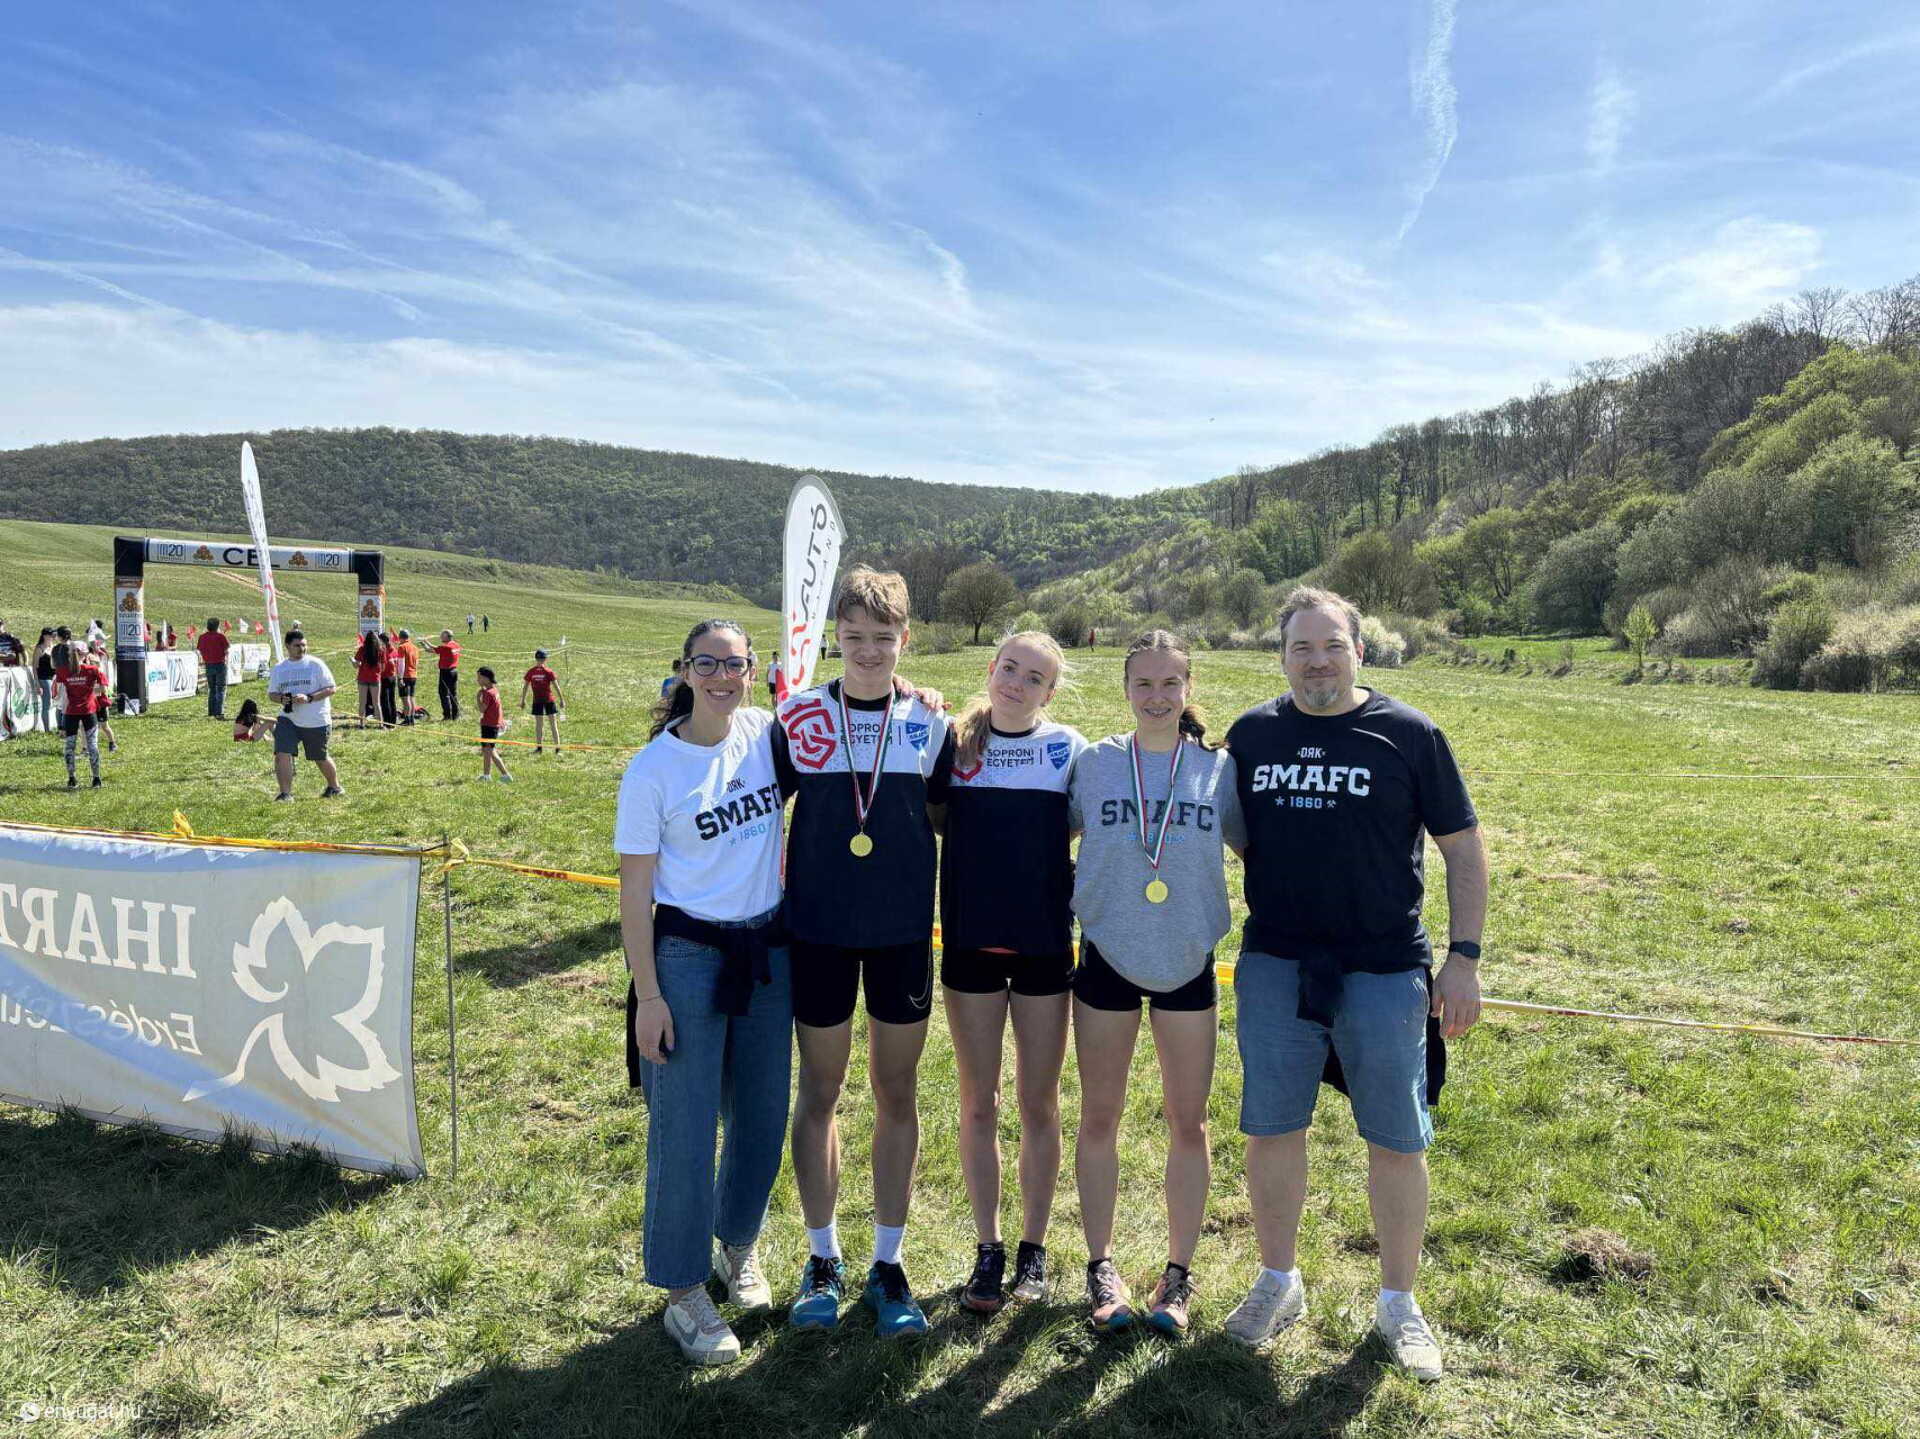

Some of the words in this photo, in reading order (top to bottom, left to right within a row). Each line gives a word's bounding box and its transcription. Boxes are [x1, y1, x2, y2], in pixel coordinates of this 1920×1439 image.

[223, 547, 281, 568] CE
[987, 748, 1034, 758] SOPRONI
[1252, 764, 1371, 797] SMAFC
[1290, 796, 1322, 809] 1860
